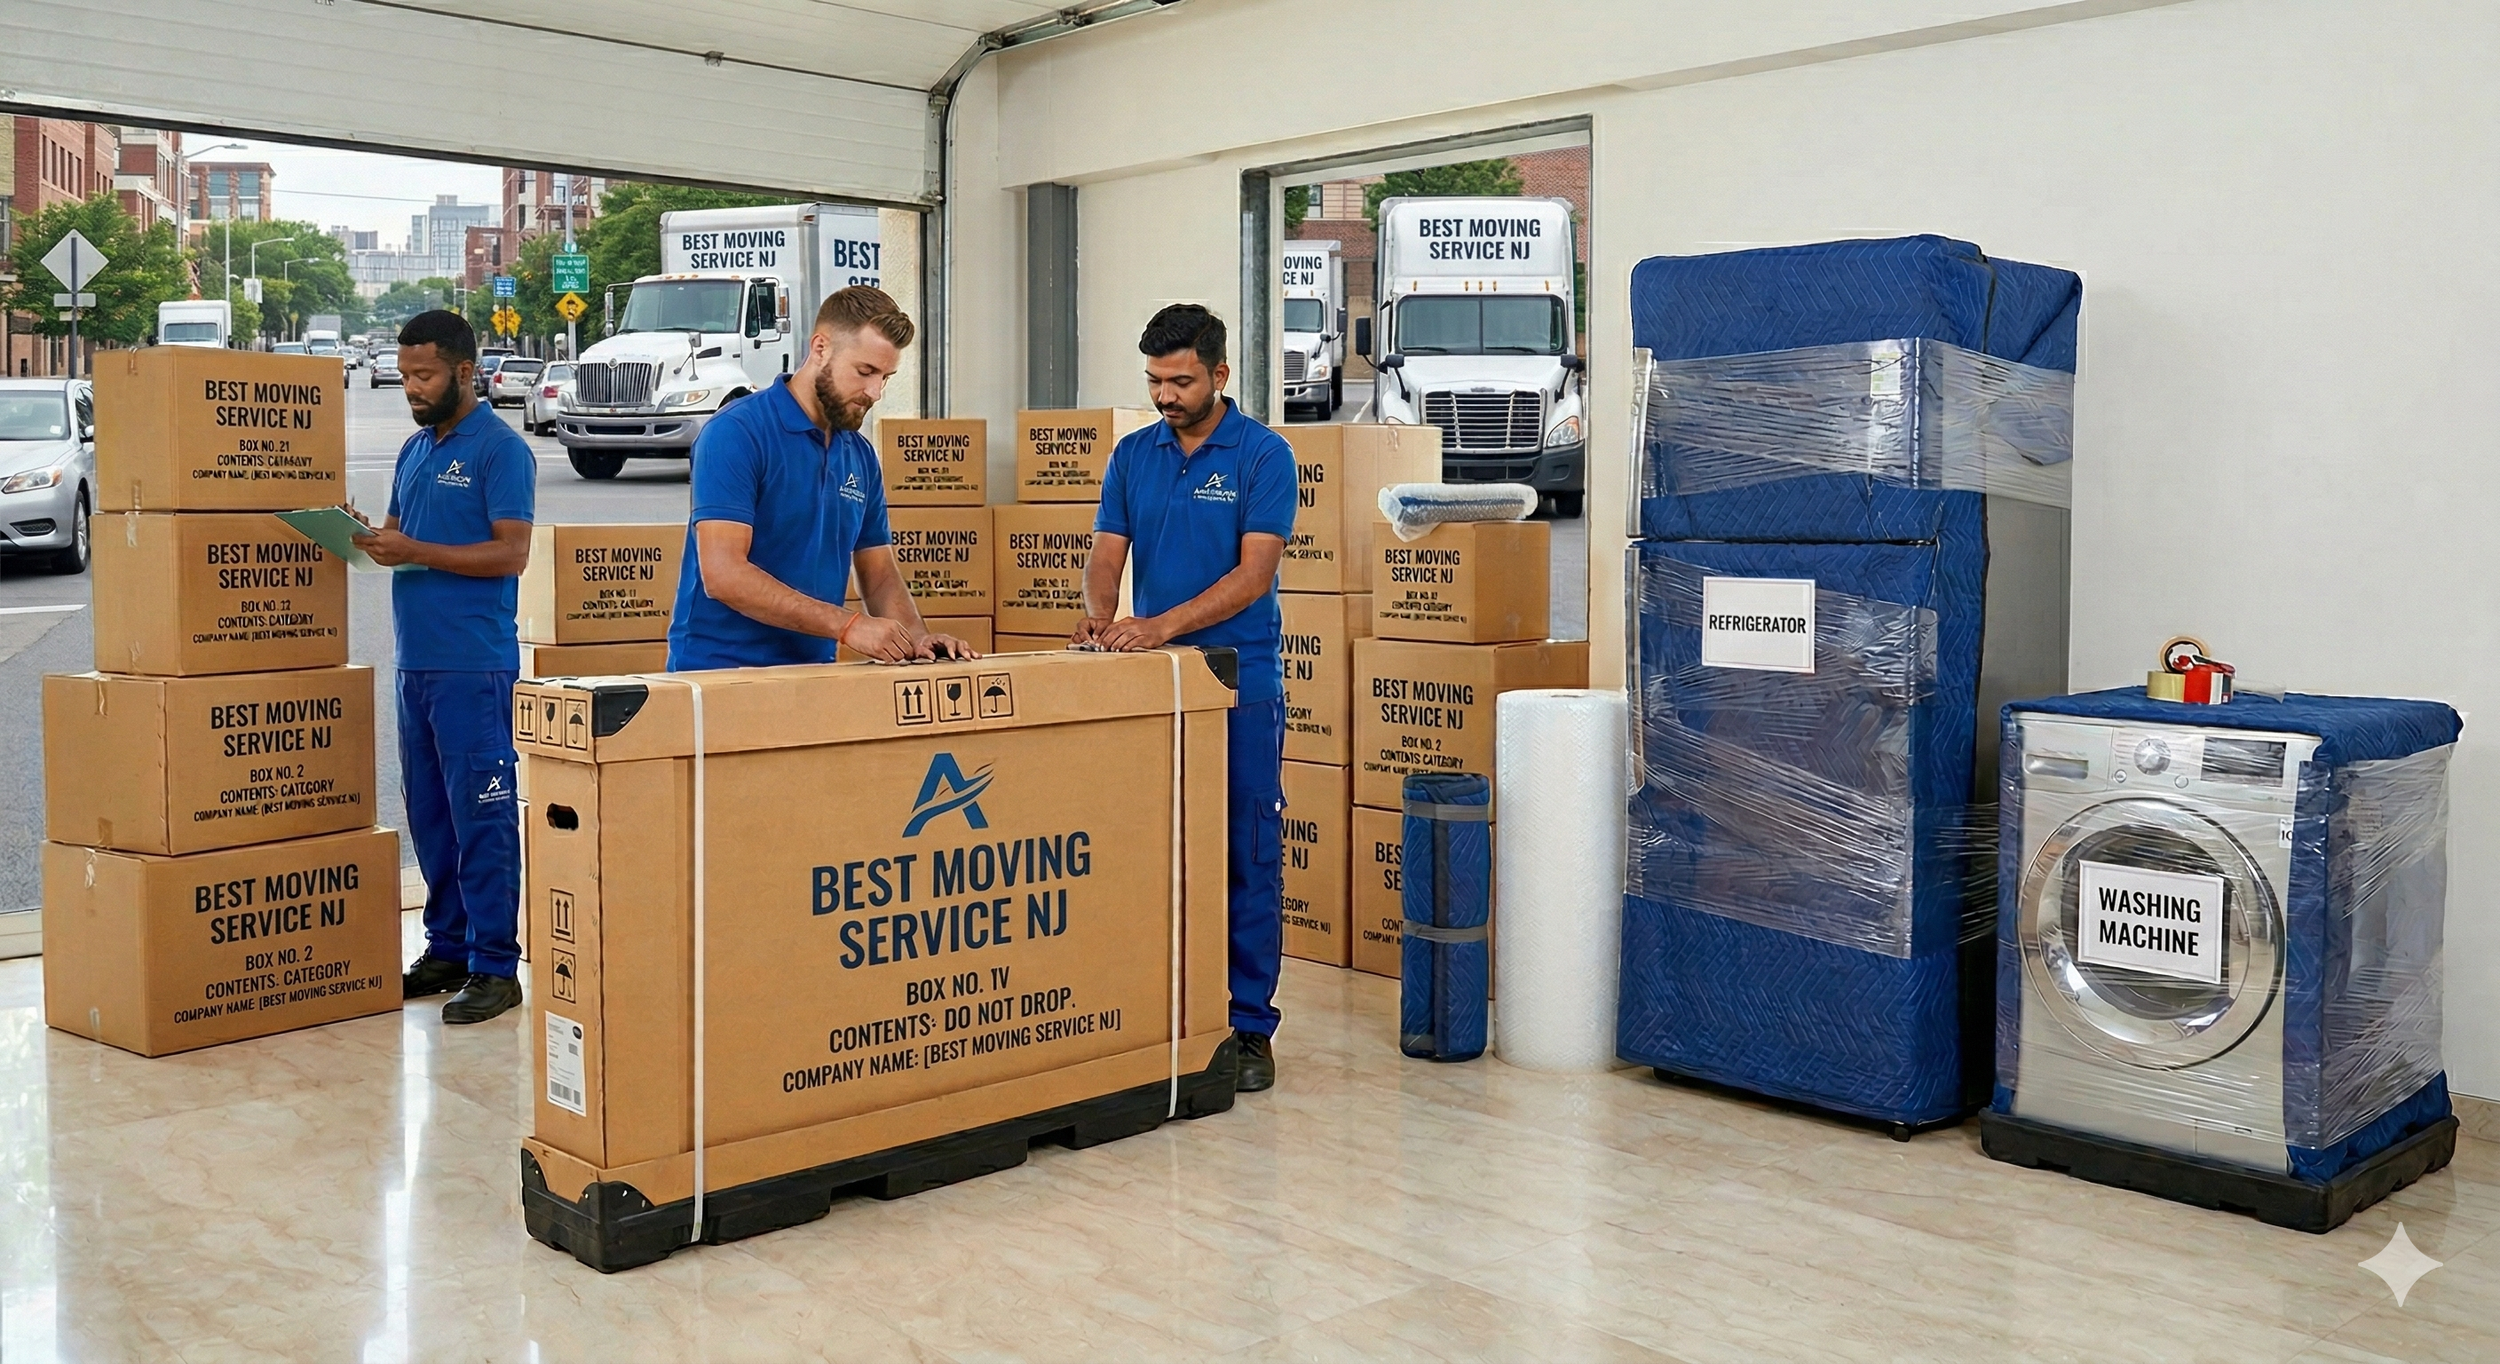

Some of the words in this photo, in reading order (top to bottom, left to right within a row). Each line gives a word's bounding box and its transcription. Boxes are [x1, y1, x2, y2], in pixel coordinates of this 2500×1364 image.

[1419, 218, 1463, 238] BEST
[1469, 218, 1541, 238] MOVING
[682, 233, 719, 250] BEST
[724, 230, 785, 249] MOVING
[691, 251, 754, 269] SERVICE
[759, 250, 776, 267] NJ
[834, 239, 881, 270] BEST
[1429, 241, 1505, 260] SERVICE
[1510, 241, 1530, 260] NJ
[1284, 256, 1322, 269] OVING
[1301, 271, 1314, 285] NJ
[205, 380, 248, 401] BEST
[254, 382, 321, 405] MOVING
[216, 406, 288, 428] SERVICE
[293, 409, 312, 429] NJ
[927, 435, 970, 448] MOVING
[1030, 428, 1054, 441] BEST
[1057, 427, 1097, 441] MOVING
[239, 439, 259, 452] BOX
[904, 449, 949, 462] SERVICE
[952, 449, 964, 462] NJ
[1080, 442, 1091, 455] NJ
[1298, 463, 1324, 483] ING
[1299, 488, 1315, 508] NJ
[891, 531, 922, 546] BEST
[926, 530, 977, 546] MOVING
[1010, 533, 1039, 550] BEST
[1043, 533, 1093, 550] MOVING
[207, 543, 250, 564] BEST
[256, 542, 323, 564] MOVING
[575, 548, 607, 563] BEST
[611, 547, 662, 563] MOVING
[897, 547, 951, 563] SERVICE
[955, 547, 969, 562] NJ
[1017, 552, 1067, 569] SERVICE
[1071, 553, 1085, 569] NJ
[1385, 549, 1412, 565] BEST
[1415, 549, 1460, 565] MOVING
[219, 567, 290, 589] SERVICE
[295, 566, 313, 587] NJ
[583, 566, 636, 581] SERVICE
[640, 565, 653, 580] NJ
[1392, 567, 1437, 583] SERVICE
[1440, 568, 1453, 584] NJ
[1709, 614, 1806, 634] REFRIGERATOR
[1280, 634, 1321, 656] VING
[1296, 660, 1313, 680] NJ
[1373, 678, 1408, 700] BEST
[1413, 681, 1473, 705] MOVING
[211, 703, 259, 729] BEST
[266, 697, 342, 724] MOVING
[1381, 703, 1442, 728] SERVICE
[1447, 709, 1463, 730] NJ
[224, 728, 305, 757] SERVICE
[312, 726, 331, 749] NJ
[1436, 739, 1441, 751] 2
[250, 767, 273, 783] BOX
[276, 765, 294, 780] NO.
[297, 764, 304, 778] 2
[1281, 817, 1318, 844] VING
[1292, 846, 1308, 870] NJ
[1375, 841, 1402, 865] BES
[812, 854, 917, 916] BEST
[932, 831, 1091, 899] MOVING
[195, 878, 256, 914] BEST
[265, 863, 359, 903] MOVING
[1281, 895, 1309, 913] EGORY
[2099, 886, 2201, 923] WASHING
[210, 903, 312, 945] SERVICE
[320, 898, 345, 927] NJ
[839, 897, 1012, 970] SERVICE
[1027, 889, 1067, 939] NJ
[2099, 919, 2199, 957] MACHINE
[245, 951, 274, 971] BOX
[277, 948, 300, 966] NO.
[304, 945, 313, 962] 2
[205, 973, 280, 1000] CONTENTS:
[283, 959, 351, 986] CATEGORY
[174, 1003, 224, 1024] COMPANY
[226, 998, 255, 1015] NAME
[259, 992, 287, 1011] [BEST
[289, 985, 327, 1003] MOVING
[328, 977, 366, 996] SERVICE
[906, 980, 947, 1006] BOX
[952, 975, 984, 998] NO.
[829, 1012, 938, 1054] CONTENTS:
[944, 1007, 971, 1032] DO
[977, 996, 1014, 1026] NOT
[1020, 986, 1077, 1018] DROP.
[783, 1058, 865, 1093] COMPANY
[869, 1048, 920, 1077] NAME:
[923, 1039, 968, 1070] [BEST
[971, 1026, 1032, 1055] MOVING
[1035, 1013, 1095, 1043] SERVICE
[1099, 1008, 1122, 1033] NJ]
